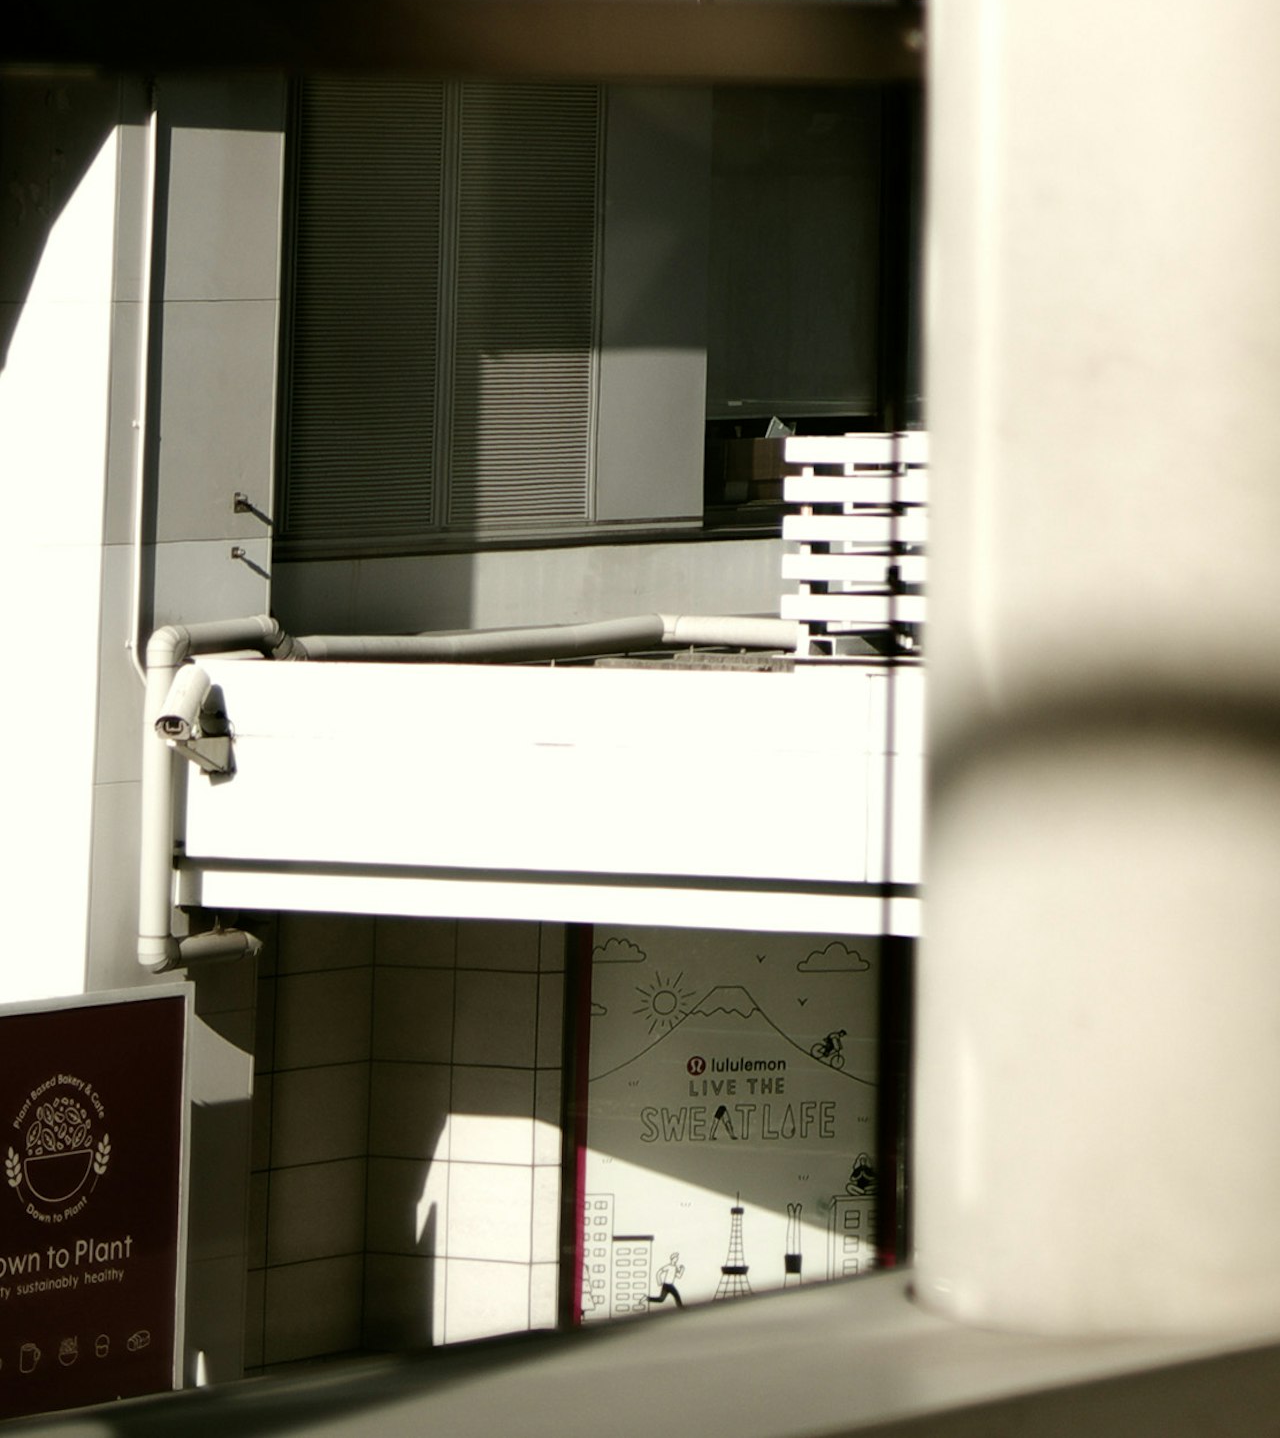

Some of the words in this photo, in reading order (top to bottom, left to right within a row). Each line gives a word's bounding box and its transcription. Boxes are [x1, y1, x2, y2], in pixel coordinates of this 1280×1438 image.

[711, 1058, 786, 1072] lululemon
[689, 1080, 736, 1096] LIVE
[747, 1078, 784, 1095] THE
[13, 1100, 32, 1129] Plant
[30, 1077, 56, 1100] Based
[57, 1073, 85, 1091] Bakery
[85, 1083, 92, 1096] &
[26, 1203, 51, 1223] Down
[53, 1213, 63, 1223] to
[64, 1196, 87, 1221] Plant
[47, 1245, 70, 1269] to
[75, 1235, 133, 1265] Plant
[16, 1275, 78, 1296] sustainably
[84, 1268, 124, 1286] healthy
